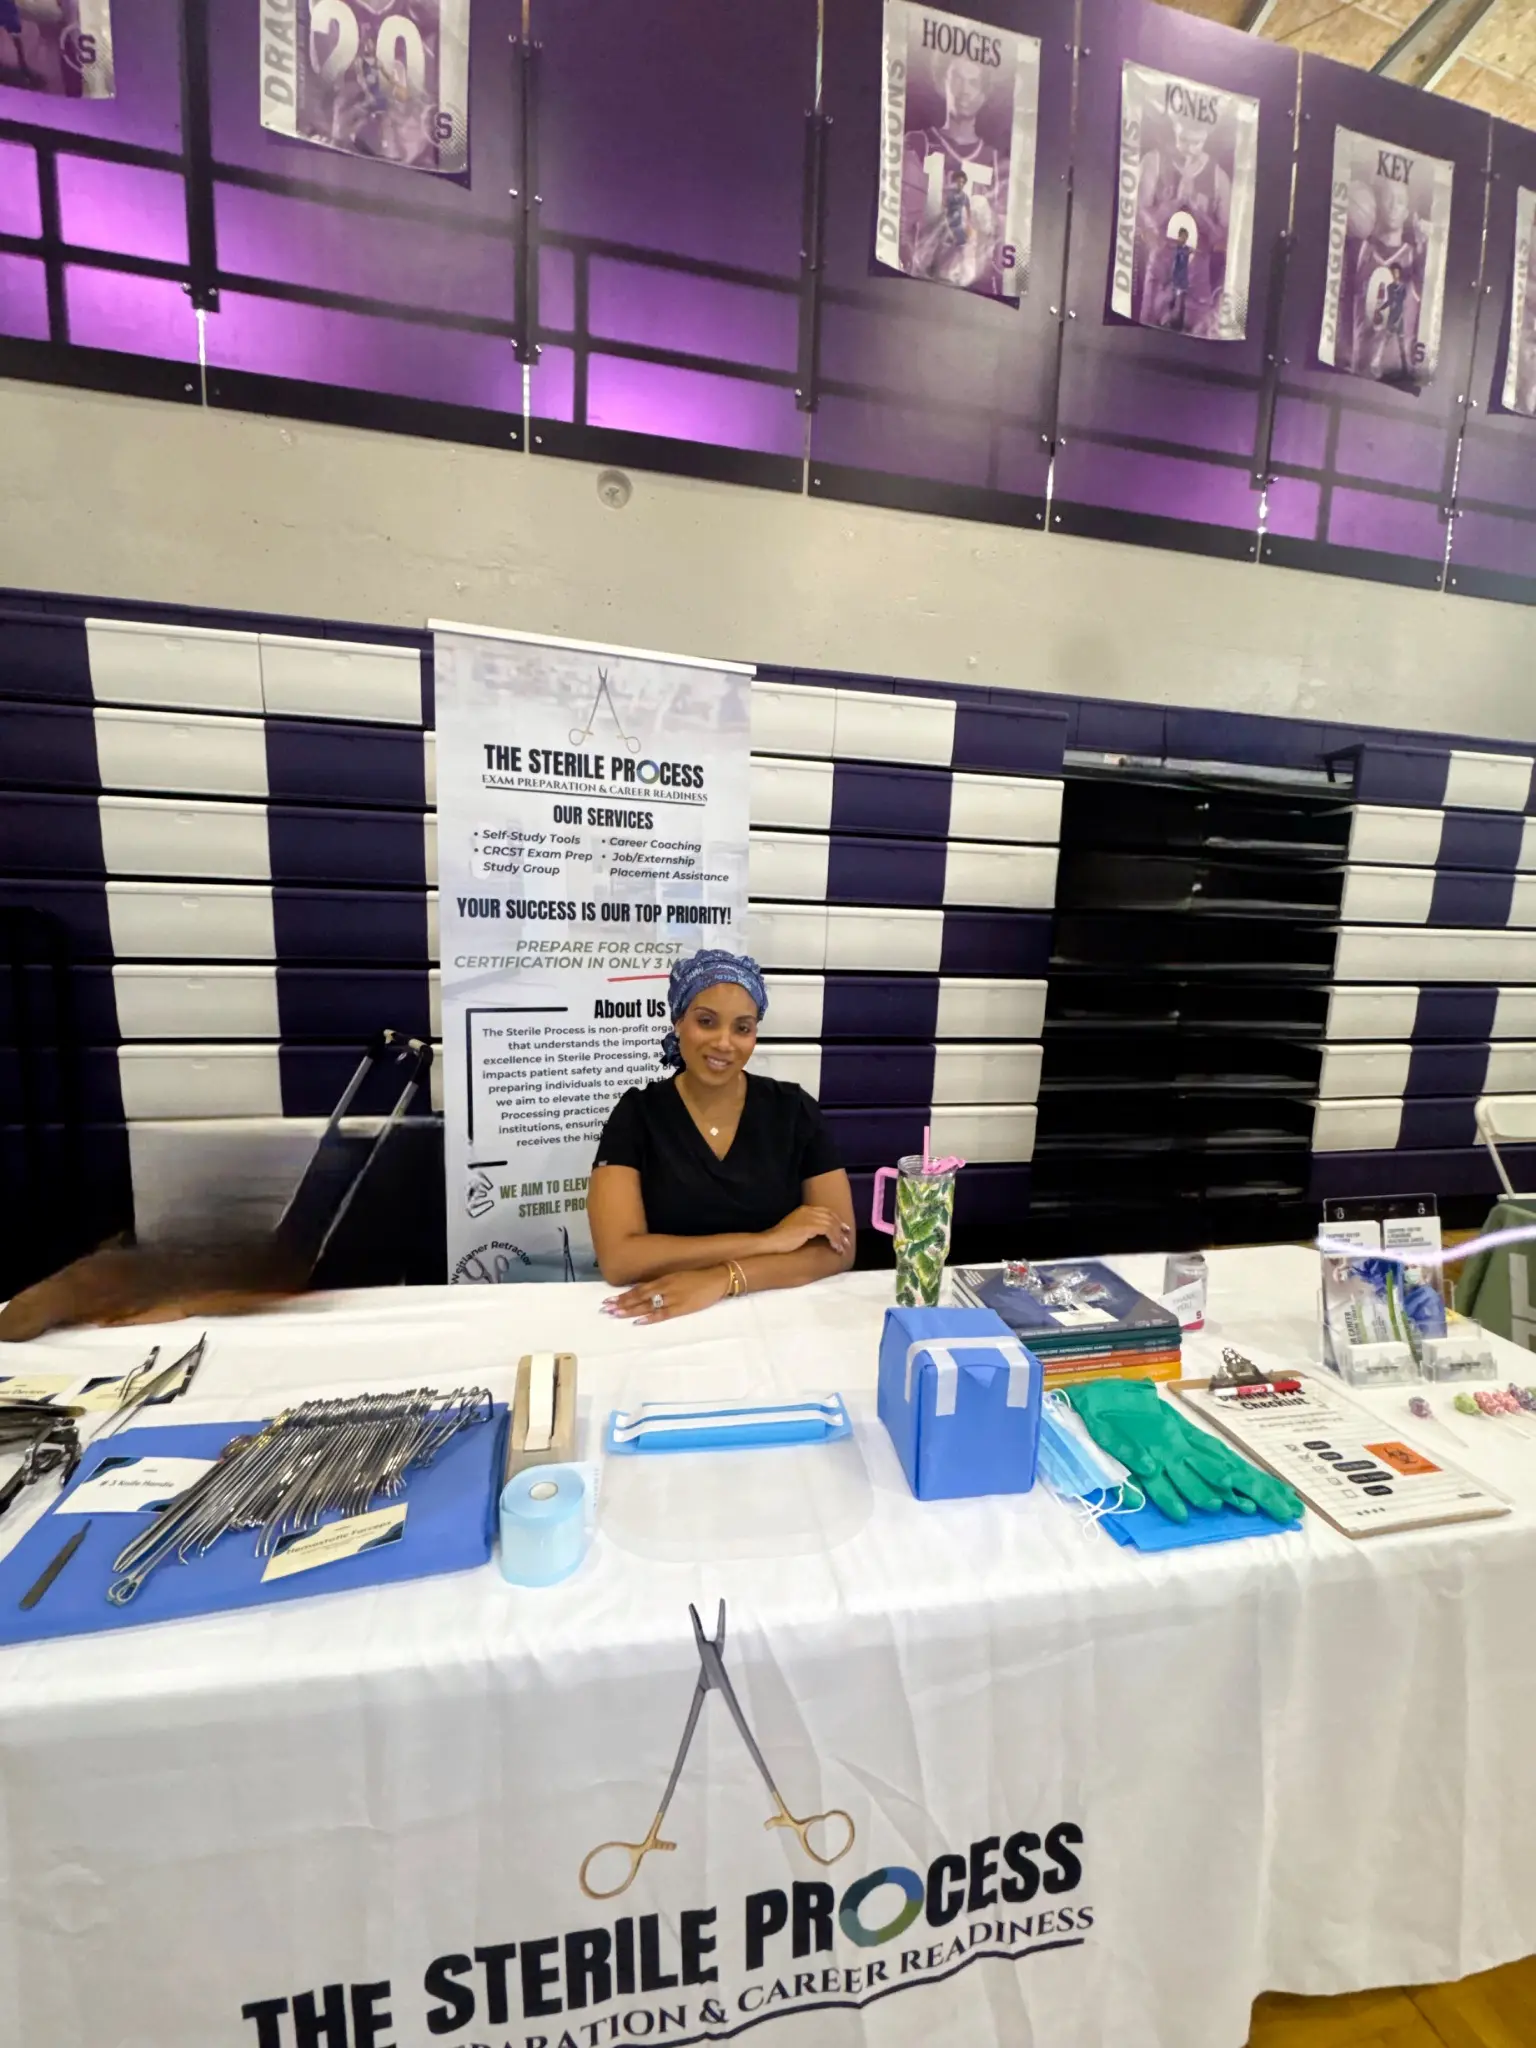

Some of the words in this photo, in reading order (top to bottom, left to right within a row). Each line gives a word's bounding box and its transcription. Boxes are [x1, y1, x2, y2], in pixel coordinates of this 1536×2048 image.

[310, 0, 426, 96] 20
[922, 18, 1002, 68] HODGES
[1164, 82, 1218, 126] JONES
[436, 112, 453, 139] S
[879, 58, 906, 244] DRAGONS
[1376, 150, 1414, 185] KEY
[1115, 119, 1140, 295] DRAGONS
[1002, 245, 1016, 268] S
[484, 744, 522, 772] THE
[529, 748, 605, 780] STERILE
[612, 757, 704, 788] PROCESS
[482, 774, 514, 786] EXAM
[518, 776, 596, 792] PREPARATION
[599, 785, 607, 794] &
[609, 786, 651, 797] CAREER
[653, 789, 708, 802] READINESS
[554, 805, 582, 825] OUR
[588, 808, 654, 829] SERVICES
[483, 830, 546, 844] Self-Study
[550, 833, 581, 845] Tools
[610, 838, 647, 849] Career
[650, 839, 701, 853] Coaching
[483, 846, 525, 857] CRCST
[528, 849, 561, 860] Exam
[565, 852, 593, 862] Prep
[612, 853, 695, 866] Job/Externship
[483, 862, 519, 875] Study
[523, 864, 560, 876] Group
[610, 867, 669, 879] Placement
[673, 870, 729, 882] Assistance
[457, 898, 500, 918] YOUR
[506, 900, 576, 920] SUCCESS
[582, 902, 596, 922] IS
[601, 902, 630, 922] OUR
[635, 904, 661, 923] TOP
[667, 906, 731, 925] PRIORITY!
[516, 940, 593, 953] PREPARE
[598, 941, 630, 953] FOR
[634, 943, 683, 954] CRCST
[454, 955, 584, 969] CERTIFICATION
[588, 957, 603, 969] IN
[608, 957, 650, 970] ONLY
[653, 958, 663, 970] 3
[594, 999, 642, 1018] About
[647, 999, 666, 1018] Us
[483, 1027, 503, 1037] The
[506, 1027, 541, 1036] Sterile
[544, 1026, 585, 1035] Process
[588, 1025, 596, 1034] is
[599, 1024, 648, 1034] non-profit
[652, 1025, 673, 1033] orga
[508, 1041, 531, 1050] that
[534, 1039, 600, 1049] understands
[603, 1039, 619, 1047] the
[622, 1038, 661, 1047] importa
[483, 1054, 541, 1065] excellence
[545, 1054, 555, 1063] in
[558, 1052, 591, 1062] Sterile
[594, 1051, 650, 1060] Processing,
[483, 1069, 527, 1080] impacts
[530, 1068, 568, 1079] patient
[571, 1067, 602, 1076] safety
[605, 1065, 623, 1073] and
[626, 1063, 660, 1073] quality
[489, 1083, 542, 1095] preparing
[545, 1079, 602, 1090] individuals
[617, 1077, 642, 1085] excel
[496, 1099, 512, 1107] we
[516, 1097, 536, 1105] aim
[539, 1096, 550, 1104] to
[553, 1093, 591, 1104] elevate
[593, 1092, 610, 1101] the
[501, 1108, 560, 1120] Processing
[563, 1106, 609, 1118] practices
[499, 1122, 563, 1135] institutions,
[517, 1135, 560, 1147] receives
[564, 1133, 581, 1143] the
[500, 1185, 517, 1199] WE
[521, 1182, 543, 1197] AIM
[546, 1180, 560, 1194] TO
[563, 1177, 591, 1192] ELEV
[519, 1200, 561, 1217] STERILE
[565, 1198, 587, 1212] PRO
[491, 1241, 532, 1266] Retractor
[242, 1980, 396, 2048] THE
[424, 1905, 718, 2035] STERILE
[745, 1821, 1084, 1972] PROCESS
[699, 1999, 731, 2026] &
[738, 1960, 888, 2012] CAREER
[900, 1906, 1095, 1975] READINESS
